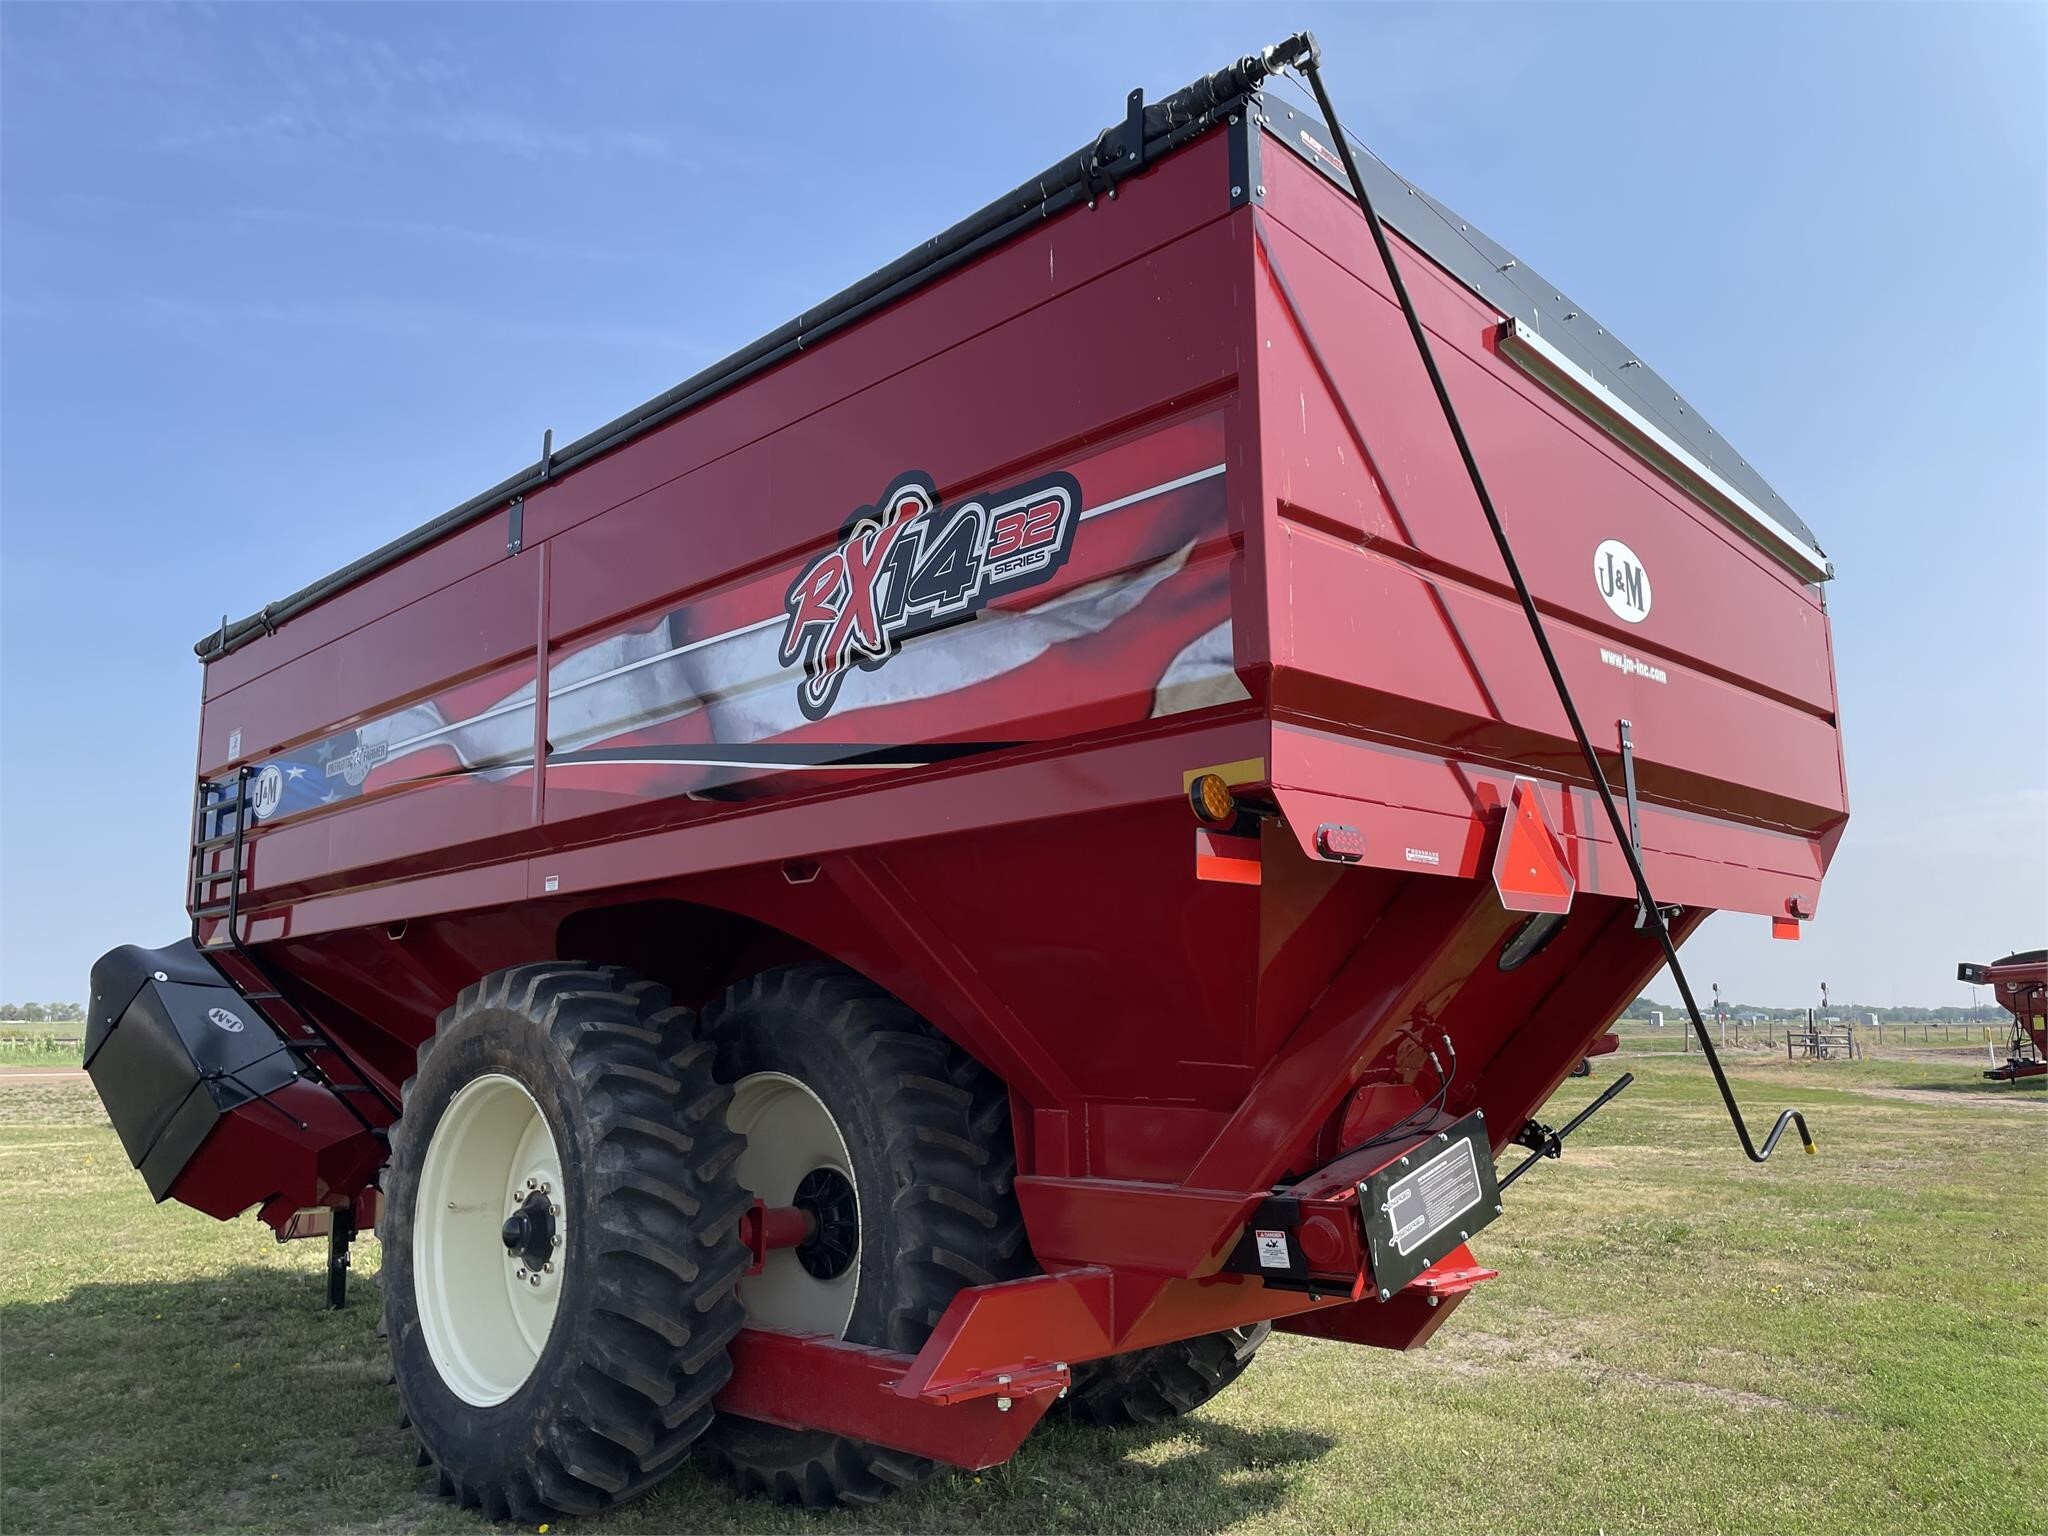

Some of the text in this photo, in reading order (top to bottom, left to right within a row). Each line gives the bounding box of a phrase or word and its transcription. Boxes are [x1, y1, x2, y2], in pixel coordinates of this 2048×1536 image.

[989, 500, 1062, 560] 32
[994, 548, 1046, 576] SERIES
[1598, 551, 1645, 613] J&M
[1600, 648, 1667, 684] www.jm-inc.com
[255, 774, 279, 808] J&M
[210, 1009, 244, 1030] J&M
